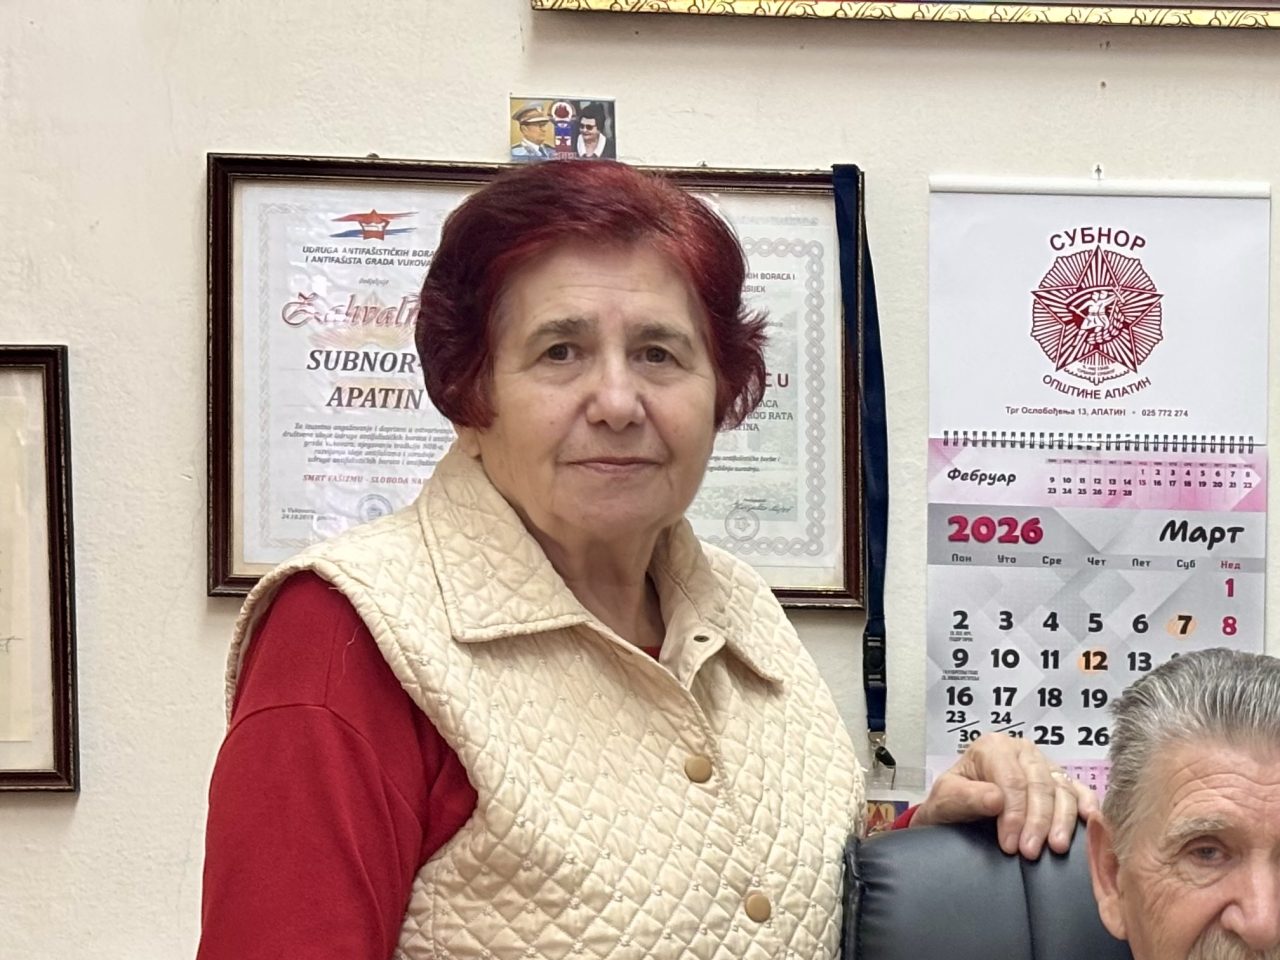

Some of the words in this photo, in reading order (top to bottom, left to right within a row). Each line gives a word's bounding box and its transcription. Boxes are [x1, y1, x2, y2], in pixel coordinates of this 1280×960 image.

[1050, 226, 1146, 252] СУБНОР
[302, 246, 338, 254] UDRUGA
[310, 256, 362, 265] ANTIFAŠISTA
[362, 258, 394, 266] GRADA
[1042, 374, 1100, 400] ОПШТИНЕ
[1104, 376, 1152, 400] АПАТИН
[325, 386, 424, 410] APATIN
[768, 412, 794, 420] RATA
[1091, 408, 1126, 416] АПАТИН
[946, 467, 1016, 486] Фебруар
[947, 515, 1044, 545] 2026
[1158, 519, 1245, 551] Март
[952, 554, 972, 563] Пон
[998, 554, 1016, 564] Уто
[1042, 556, 1062, 567] Сре
[1087, 557, 1106, 566] Чет
[1132, 558, 1151, 568] Пет
[1176, 558, 1196, 570] Суб
[1220, 560, 1241, 570] Нед
[1225, 578, 1235, 598] 1
[953, 610, 969, 630] 2
[999, 610, 1013, 630] 3
[1042, 612, 1059, 632] 4
[1088, 613, 1103, 632] 5
[1132, 614, 1148, 633] 6
[1176, 614, 1193, 635] 7
[1222, 616, 1237, 636] 8
[952, 648, 969, 668] 9
[990, 648, 1020, 668] 10
[1040, 650, 1060, 669] 11
[1082, 651, 1108, 670] 12
[1127, 652, 1152, 671] 13
[946, 686, 973, 706] 16
[992, 686, 1017, 706] 17
[1037, 687, 1062, 708] 18
[1081, 688, 1108, 708] 19
[946, 710, 966, 723] 23
[990, 712, 1012, 724] 24
[960, 730, 981, 742] 30
[1034, 726, 1065, 746] 25
[1077, 726, 1110, 746] 26
